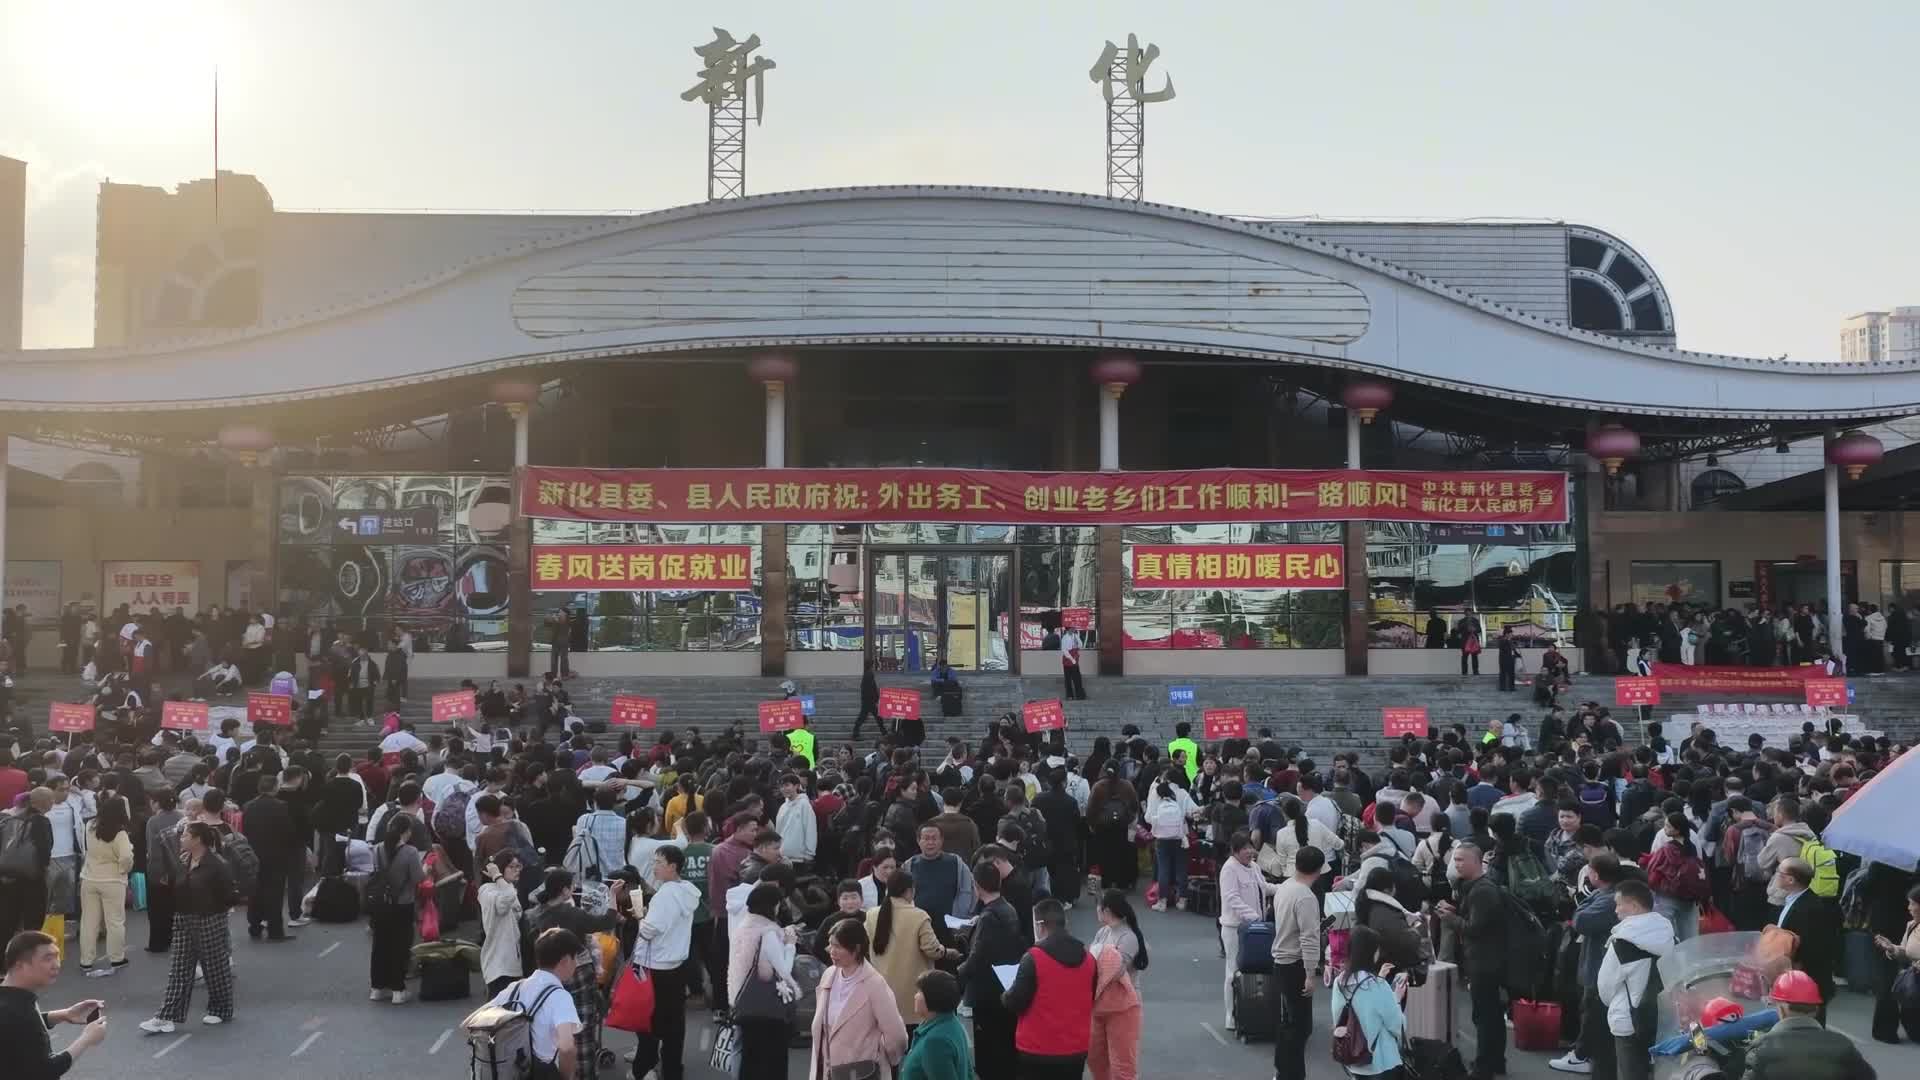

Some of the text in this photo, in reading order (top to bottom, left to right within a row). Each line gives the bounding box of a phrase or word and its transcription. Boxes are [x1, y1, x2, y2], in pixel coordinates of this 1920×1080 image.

[681, 27, 1176, 127] 新 化
[1423, 481, 1534, 497] 中共新化县委
[1422, 498, 1533, 513] 新化县人民政府
[536, 553, 748, 581] 春风送岗促就业
[1136, 553, 1340, 580] 真情相助暖民心
